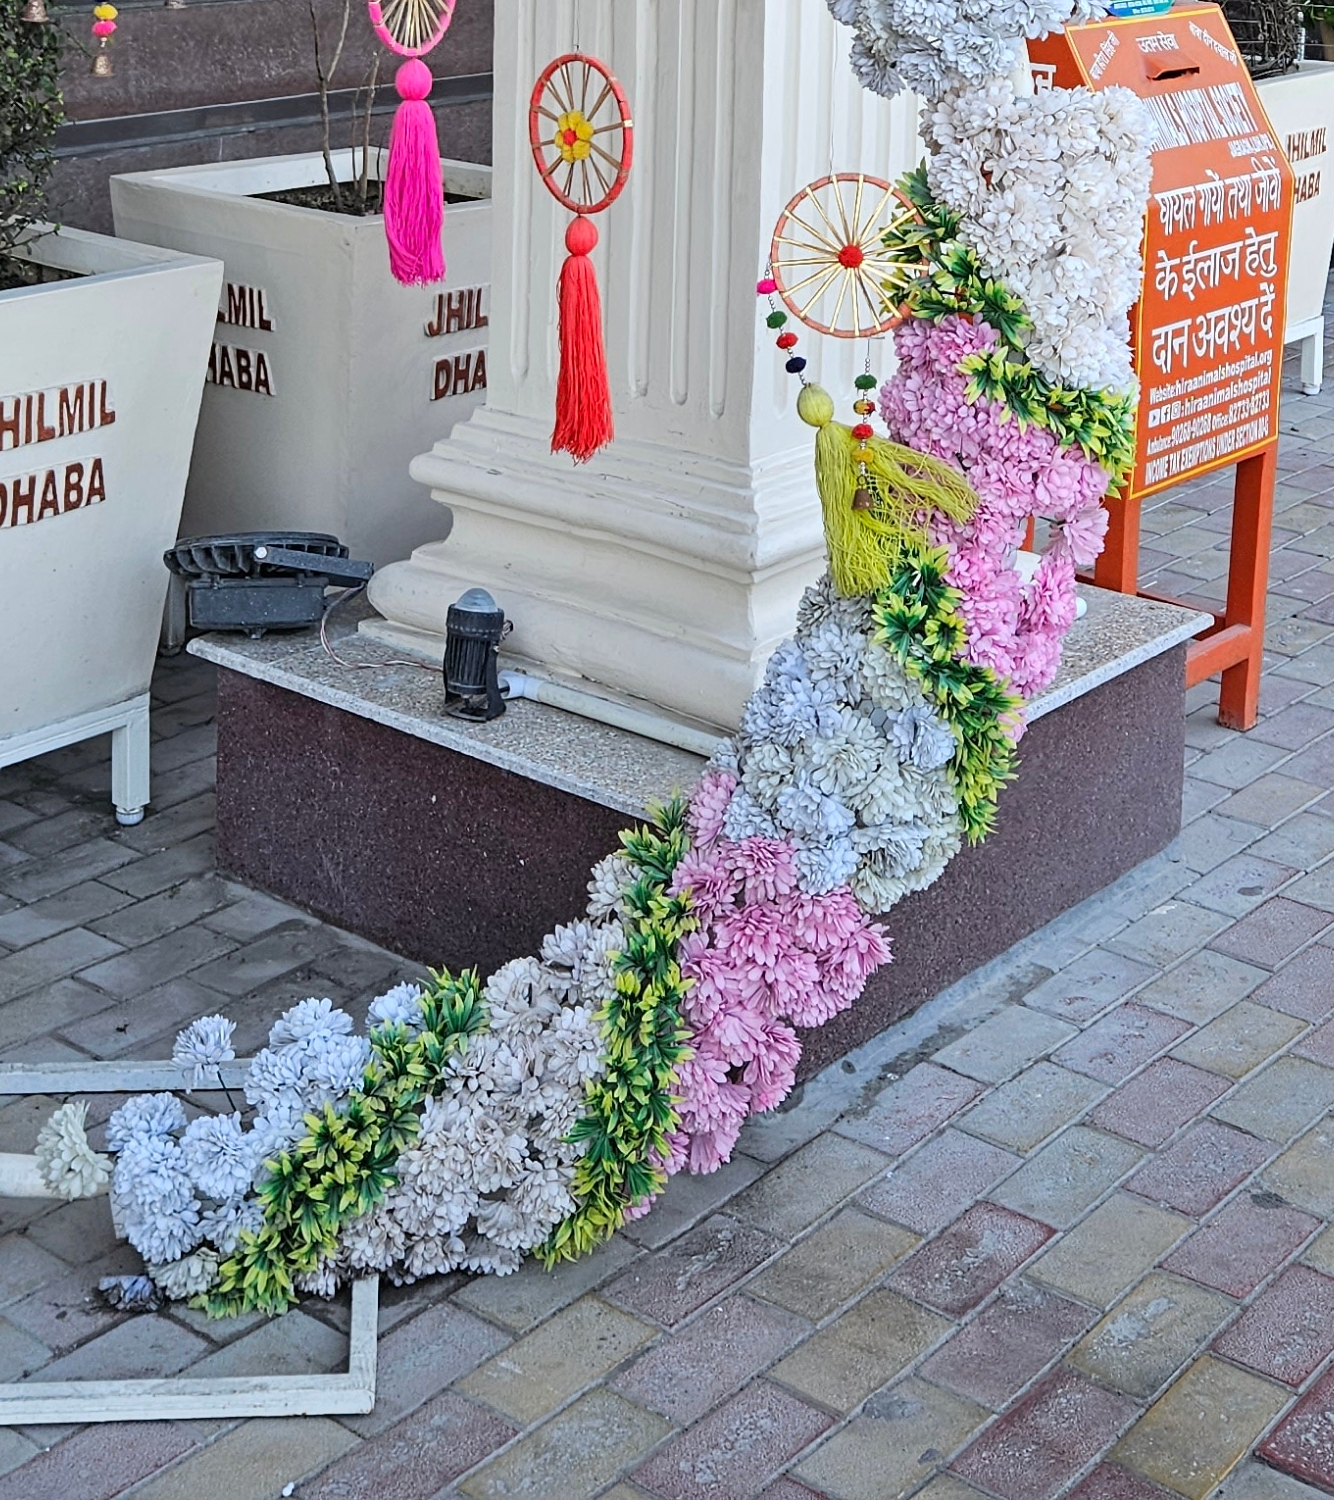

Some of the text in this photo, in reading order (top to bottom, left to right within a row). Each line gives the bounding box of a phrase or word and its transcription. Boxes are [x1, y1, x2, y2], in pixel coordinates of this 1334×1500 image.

[1154, 185, 1196, 236] घायल
[1224, 174, 1251, 220] तथा
[1293, 171, 1321, 205] HABA
[1155, 227, 1278, 301] के ईलाज हेतु
[426, 287, 489, 337] JHIL
[1152, 283, 1275, 374] दान अवश्य दें
[432, 350, 487, 401] DHA
